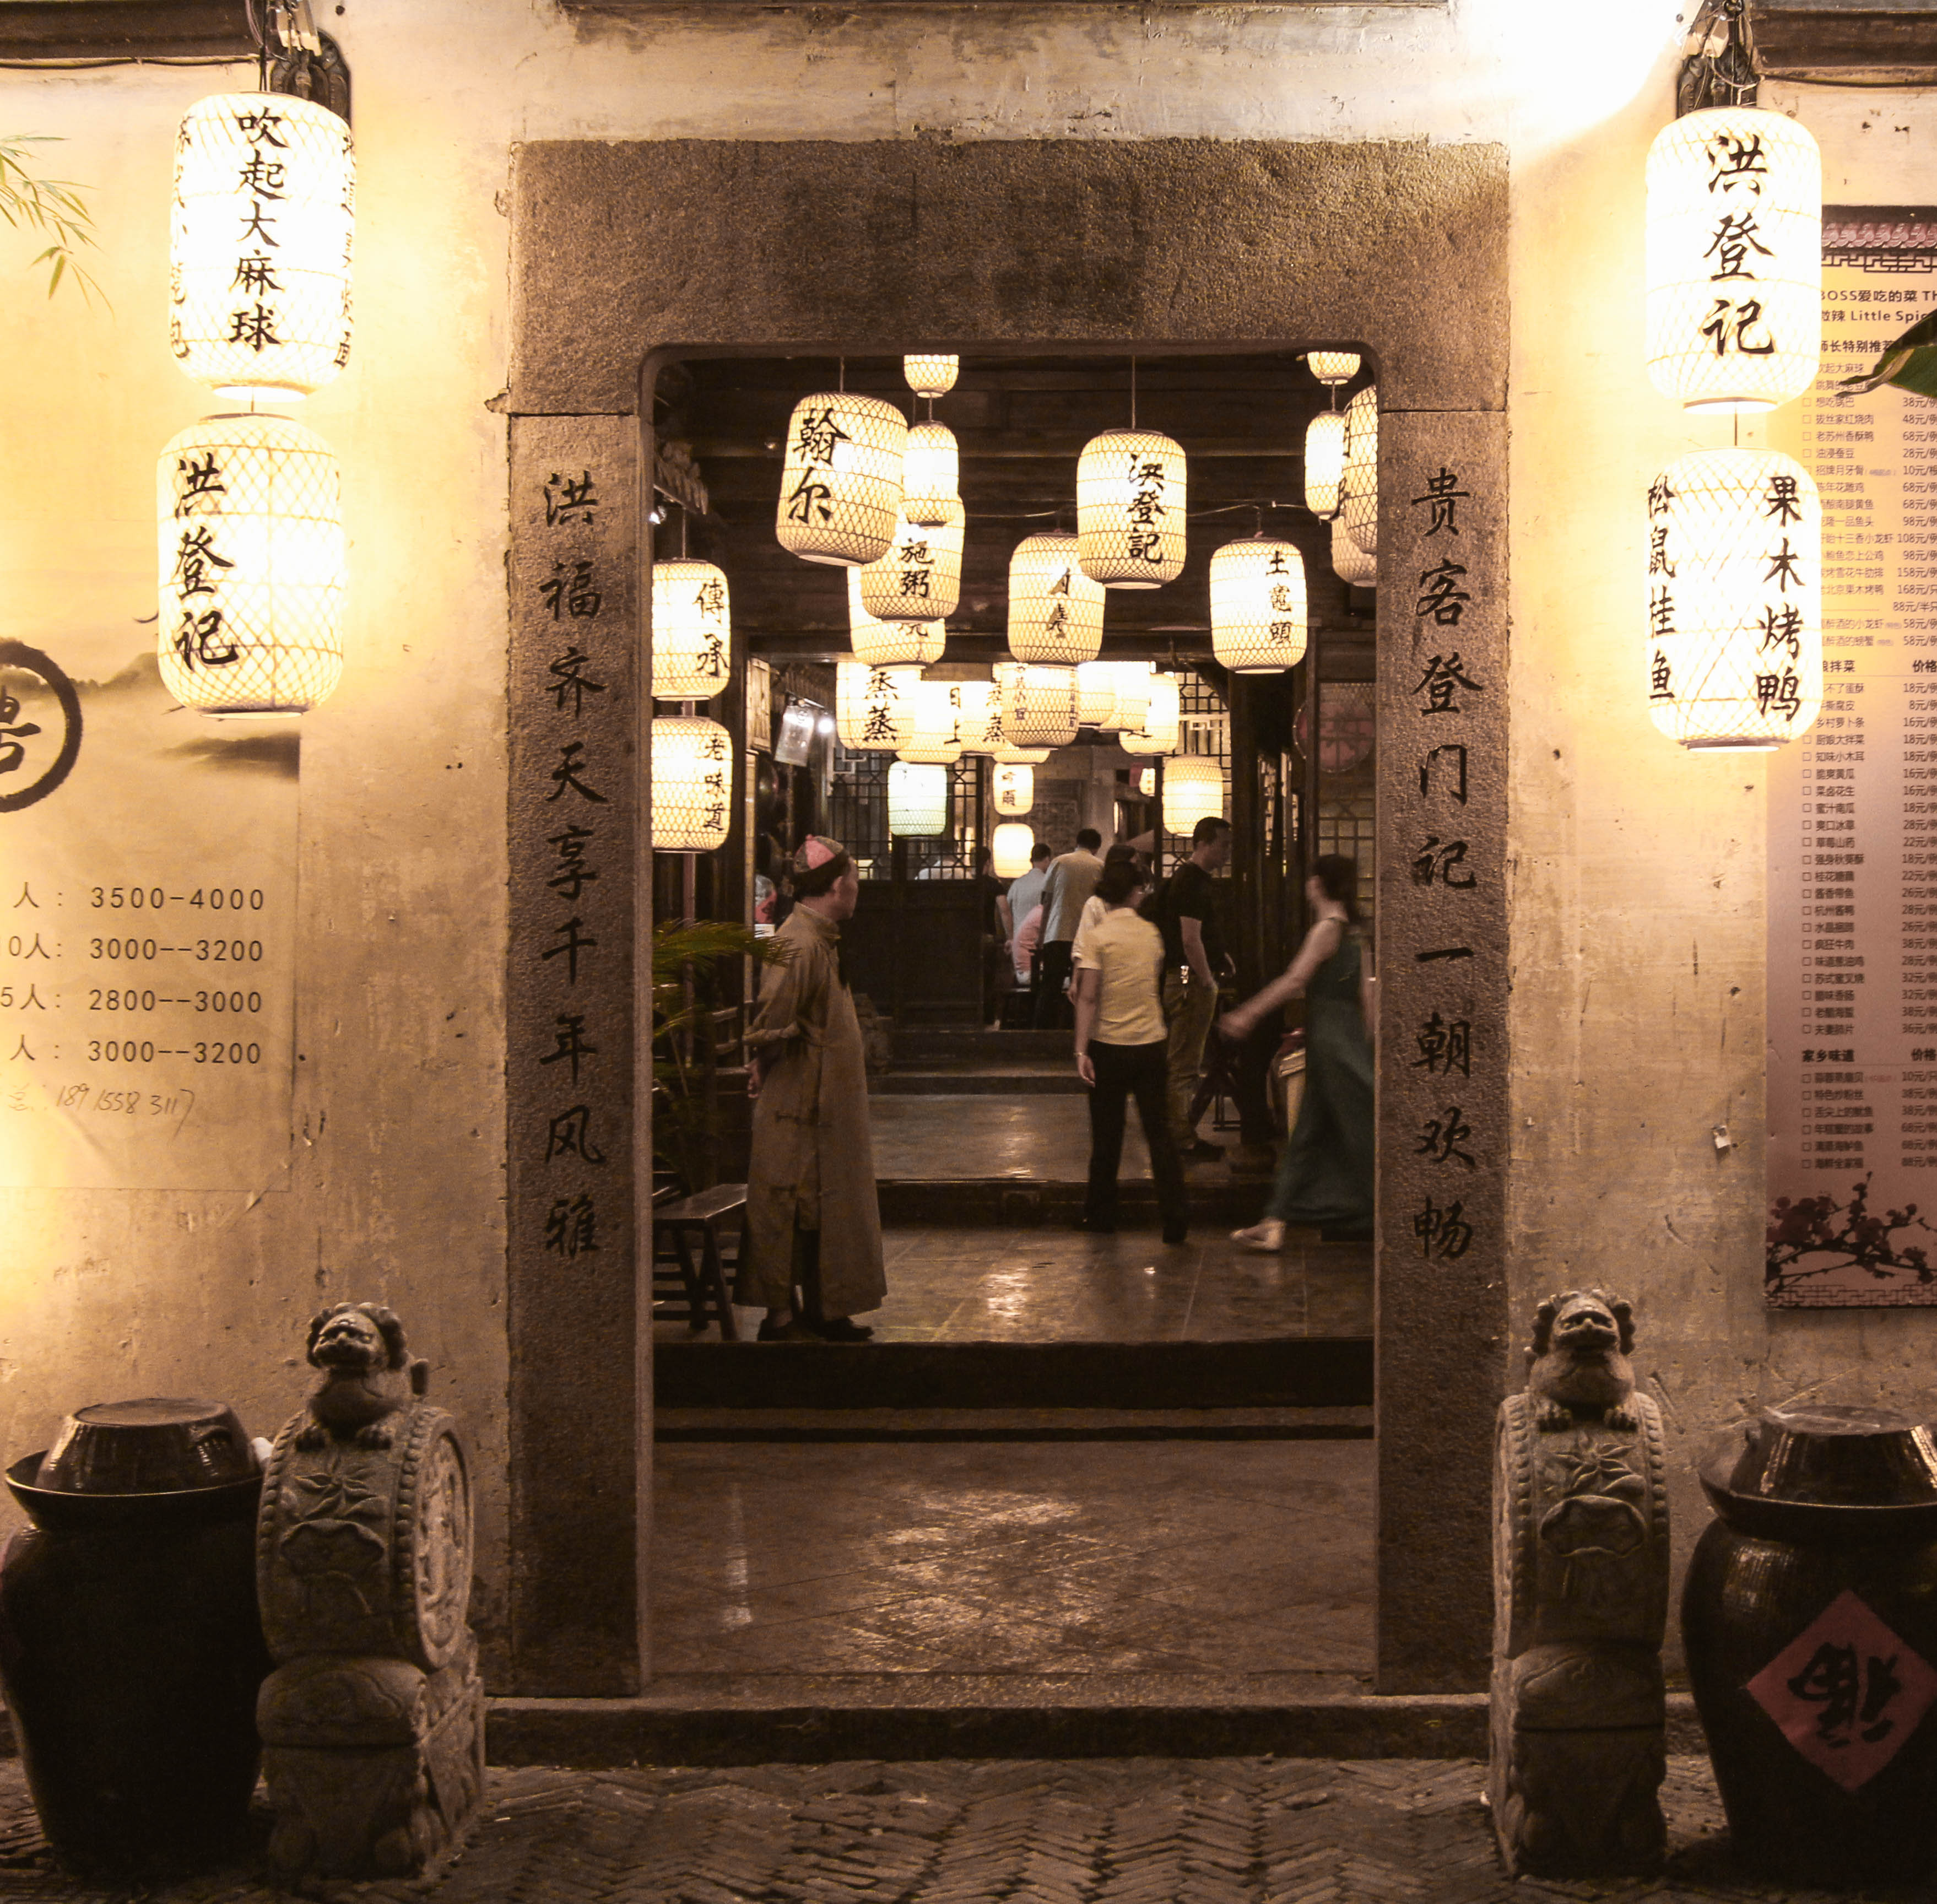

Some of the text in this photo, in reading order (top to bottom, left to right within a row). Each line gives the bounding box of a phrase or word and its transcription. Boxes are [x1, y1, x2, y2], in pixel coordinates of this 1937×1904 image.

[229, 106, 290, 353] 吹起大麻球
[1702, 134, 1775, 357] 洪登记
[1851, 311, 1891, 321] Little
[174, 452, 239, 673] 洪登记
[788, 408, 851, 524] 翰尔
[1648, 475, 1676, 700] 松鼠桂鱼
[1756, 475, 1805, 722] 果木烤鸭
[539, 469, 607, 1259] 洪福齐天享千年风雅
[1411, 467, 1482, 1259] 贵客登门记一朝欢畅
[56, 1083, 90, 1111] 189
